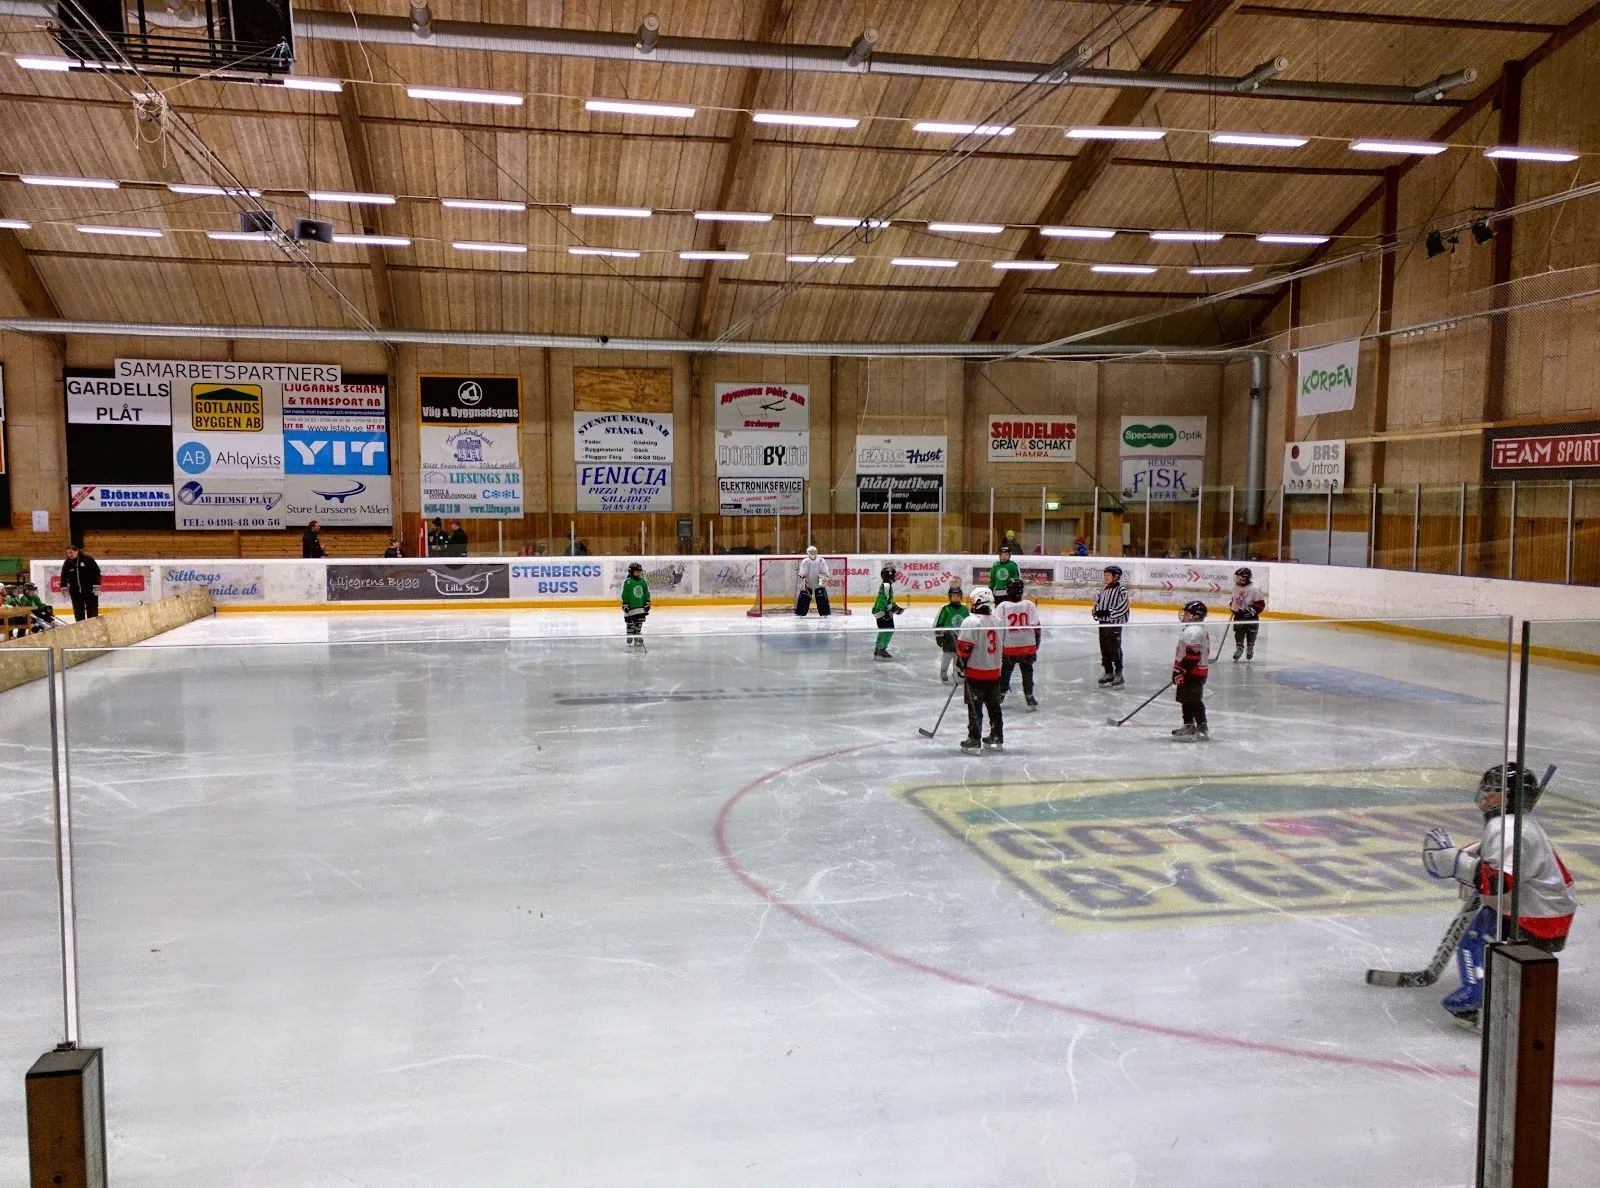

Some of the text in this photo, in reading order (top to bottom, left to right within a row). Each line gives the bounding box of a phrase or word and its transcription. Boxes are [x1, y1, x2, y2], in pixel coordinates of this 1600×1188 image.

[120, 361, 339, 382] SAMARBETSPARTNERS
[1302, 363, 1354, 395] KORPEN
[67, 381, 170, 397] GARDELLS
[284, 383, 384, 394] LJUGARNS SCHAKT
[195, 402, 260, 414] GOTLANDS
[288, 397, 381, 407] & TRANSPORT AB
[96, 403, 143, 421] PLÅT
[422, 406, 519, 419] Väg & Byggnadsgrus
[195, 416, 261, 428] BYGGEN AB
[621, 414, 656, 427] KVARN
[656, 424, 670, 437] AB
[604, 426, 644, 435] STÅNGA
[1125, 430, 1203, 441] Specsavers Optik
[991, 438, 1072, 450] GRÄV & SCHAKT
[182, 451, 206, 465] AB
[287, 440, 385, 466] YIT
[905, 447, 943, 464] Huset
[1312, 443, 1340, 461] BRS
[1496, 442, 1552, 464] TEAM
[215, 451, 281, 469] Ahlqvists
[1311, 462, 1340, 475] Intron
[449, 472, 520, 484] LIFSUNGS AB
[581, 466, 667, 486] FENICIA
[1133, 468, 1189, 494] FISK
[720, 481, 802, 491] ELEKTRONIKSERVICE
[860, 476, 940, 491] Klädbutiken
[629, 487, 660, 495] PASTA
[198, 495, 273, 504] AB HEMSE PLÅT
[905, 501, 939, 511] Ungdom
[286, 504, 390, 514] Sture Larssons Måleri
[207, 518, 249, 527] 0498-48
[511, 565, 602, 578] STENBERGS
[903, 562, 941, 570] HEMSE
[387, 576, 420, 590] Bygg
[538, 581, 578, 593] BUSS
[912, 580, 920, 590] &
[924, 571, 952, 589] Däck
[208, 583, 258, 596] mide ab
[445, 583, 480, 593] Lilla Spa
[1007, 612, 1030, 633] 20
[986, 629, 997, 655] 3
